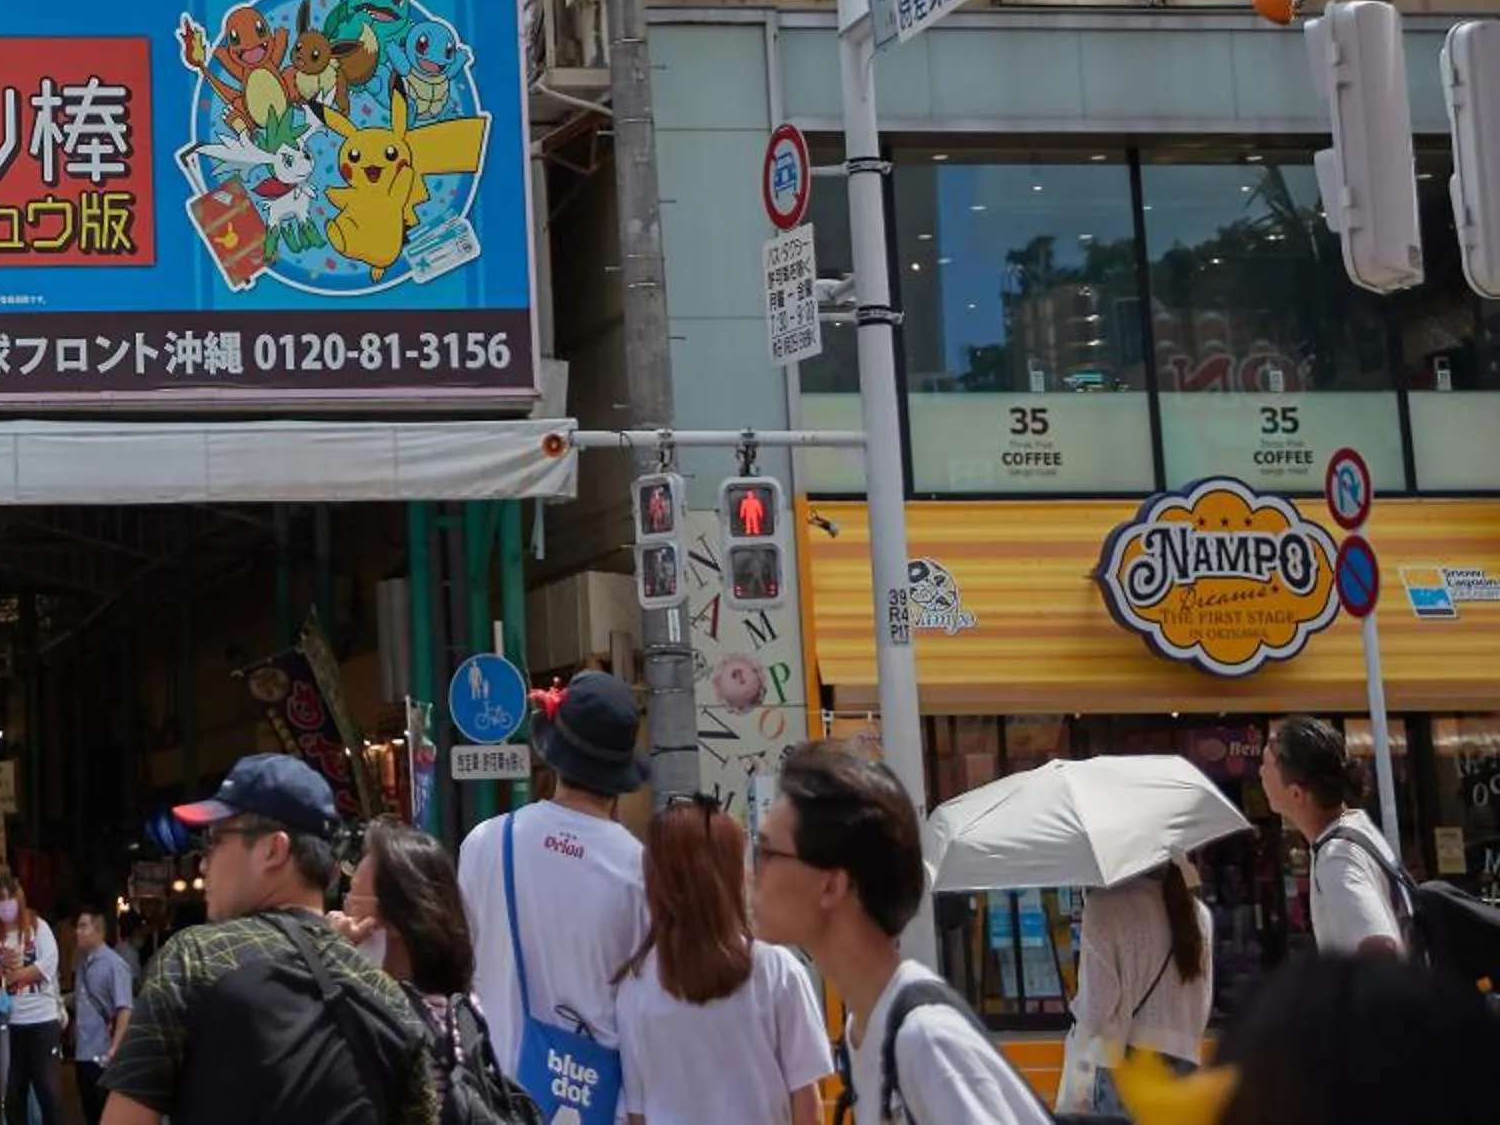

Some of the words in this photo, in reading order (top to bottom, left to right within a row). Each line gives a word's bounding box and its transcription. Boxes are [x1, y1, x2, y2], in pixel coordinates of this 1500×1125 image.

[253, 331, 512, 371] 0120-81-3156
[1009, 407, 1049, 435] 35
[1260, 406, 1300, 434] 35
[1001, 452, 1063, 466] COFFEE
[1253, 450, 1314, 465] COFFEE
[1128, 526, 1313, 602] NAMPO
[1160, 610, 1191, 624] THE
[1200, 609, 1243, 624] FIRST
[1249, 609, 1296, 624] STAGE
[547, 1047, 599, 1085] blue
[551, 1076, 592, 1107] dot
